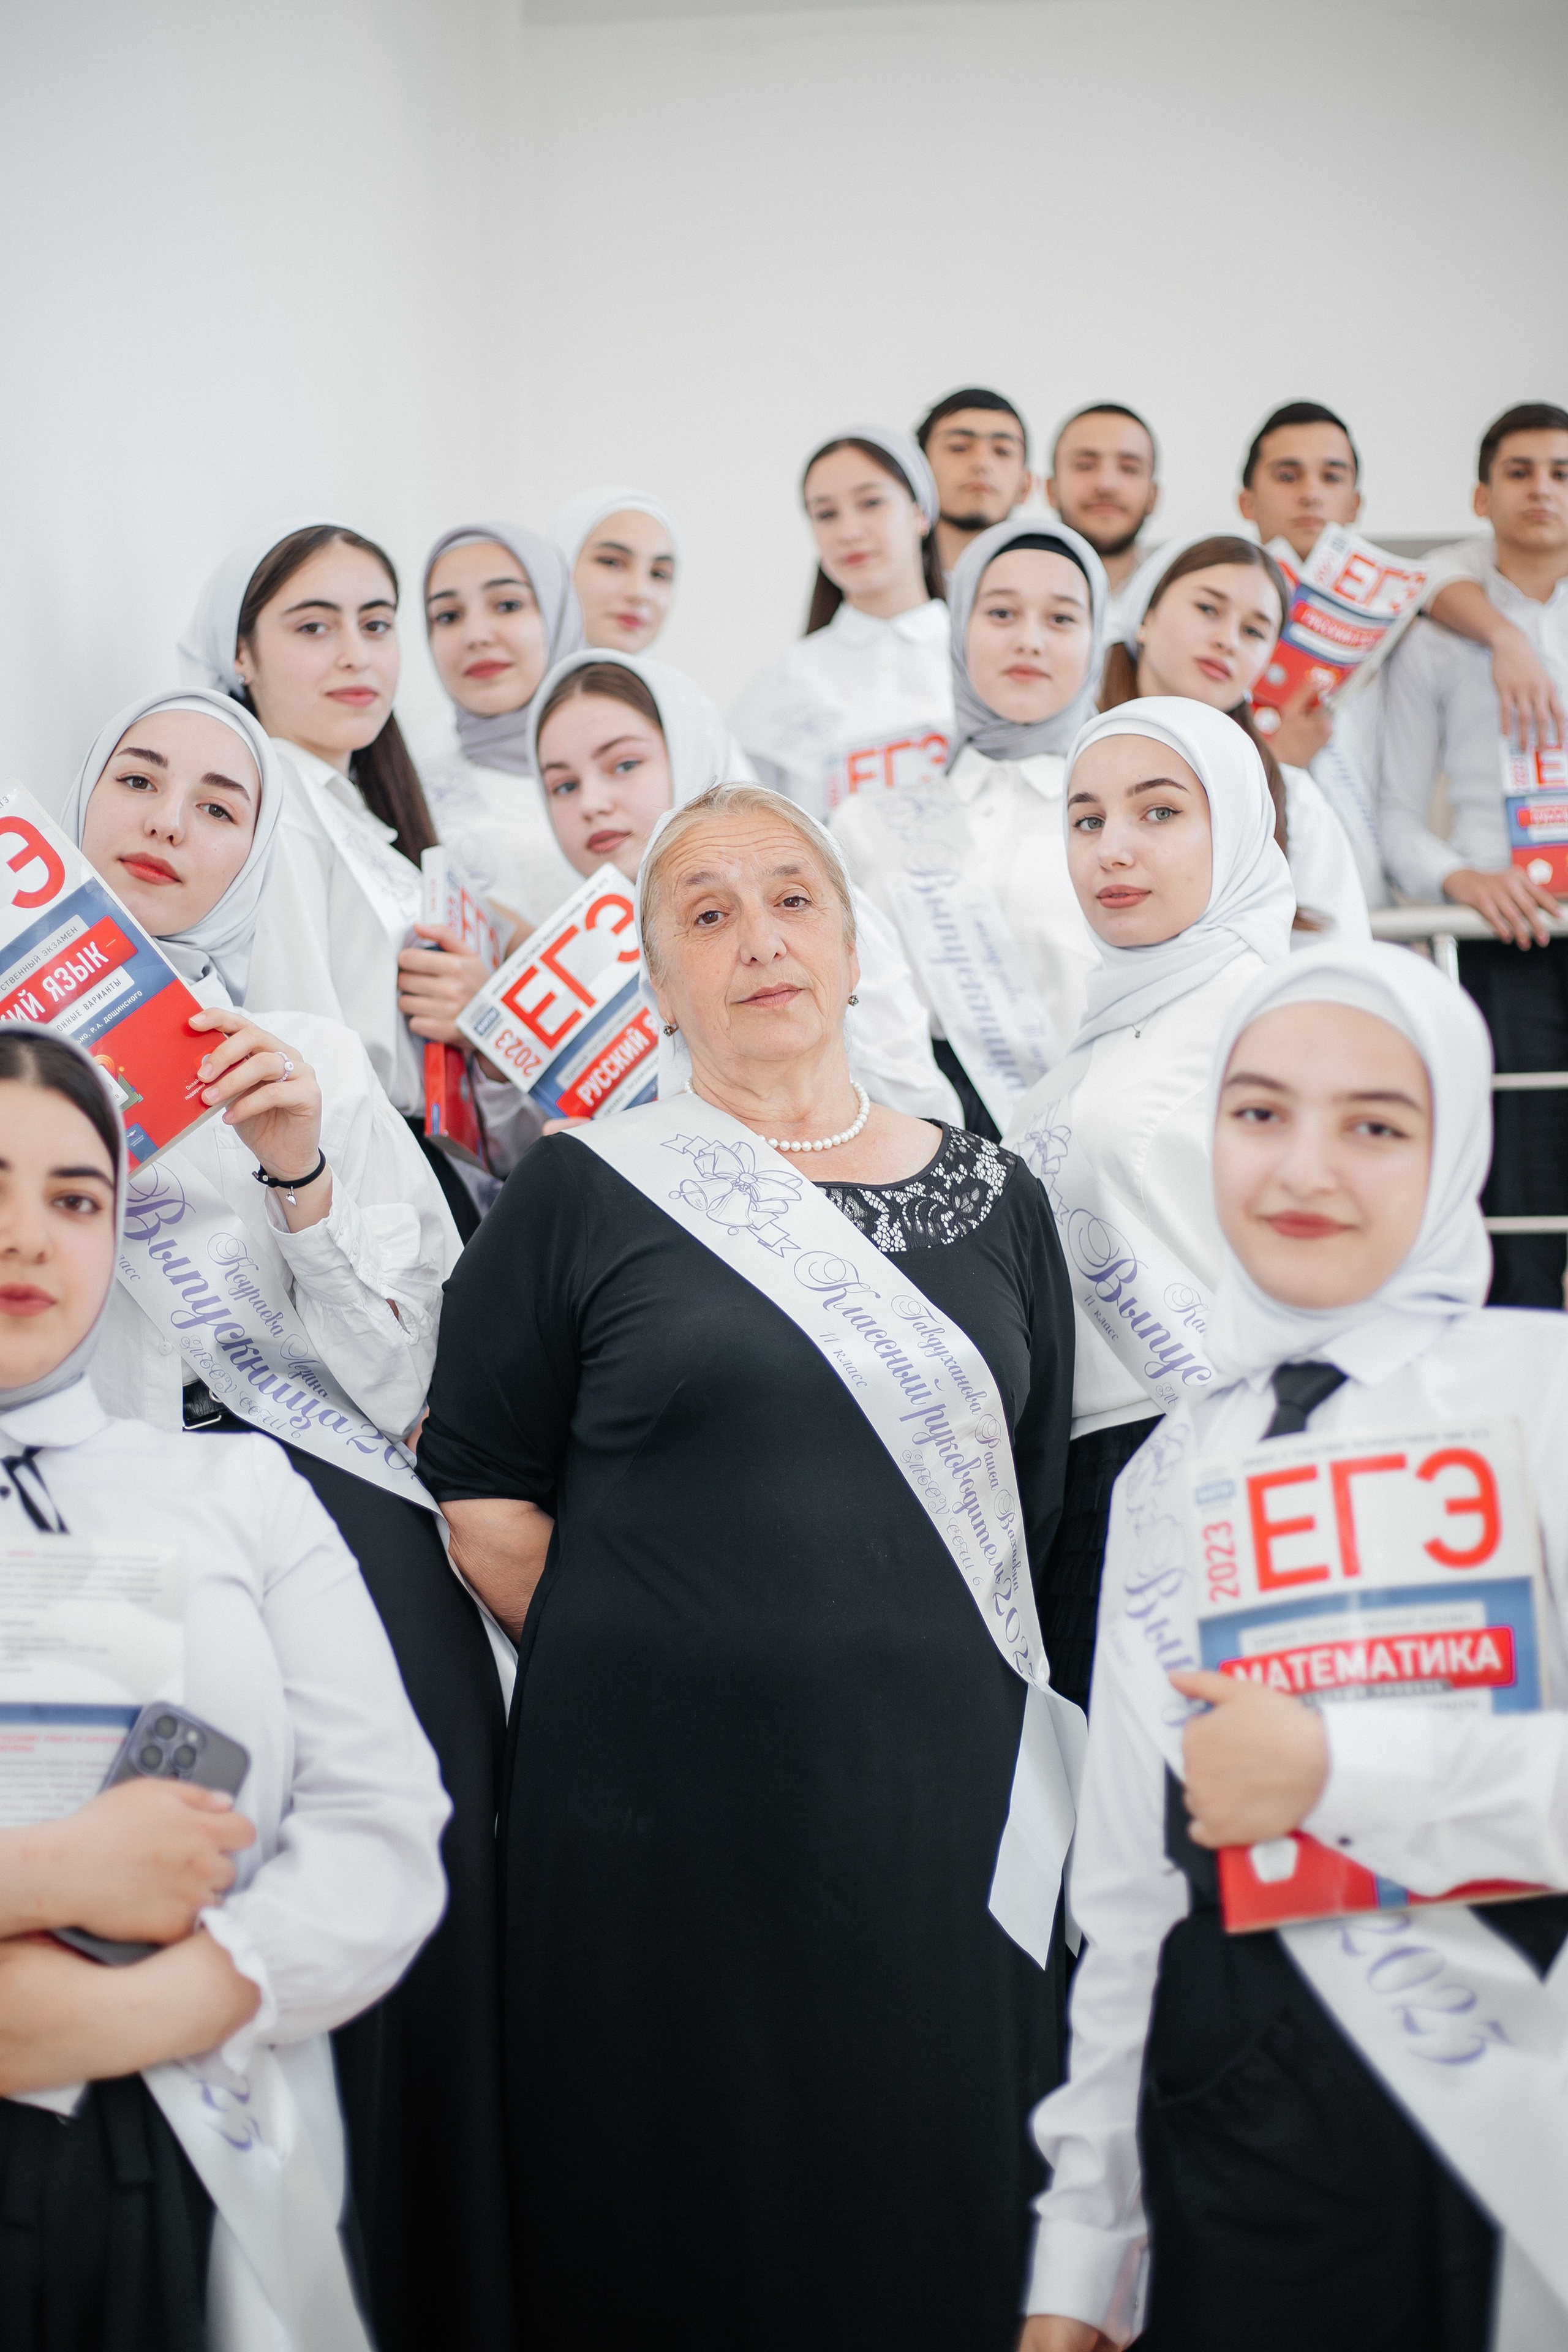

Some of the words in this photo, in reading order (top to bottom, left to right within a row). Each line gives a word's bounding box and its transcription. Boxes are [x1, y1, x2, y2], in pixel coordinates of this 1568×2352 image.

[0, 955, 42, 992] СТВЕННЫЙ
[42, 926, 78, 957] ЭКЗАМЕН
[42, 941, 110, 1003] ЯЗЫК
[500, 892, 641, 1052] ЕГЭ
[56, 1009, 82, 1031] ОННЫЕ
[83, 978, 122, 1011] ВАРИАНТЫ
[76, 1032, 91, 1044] ЬКО,
[103, 990, 143, 1024] ДОЩИНСКОГО
[495, 1029, 542, 1077] 2023
[577, 1027, 650, 1107] РУССКИЙ
[119, 1254, 141, 1281] асс
[1068, 1208, 1212, 1387] Выпус
[124, 1161, 352, 1432] Выпускница
[346, 1423, 428, 1490] 20
[1084, 1294, 1096, 1306] 11
[1094, 1310, 1119, 1341] класс
[179, 1334, 237, 1395] МБОУ
[239, 1390, 288, 1431] СОШ
[290, 1428, 301, 1439] 6
[819, 1330, 840, 1343] 11
[833, 1349, 868, 1388] класс
[891, 1294, 987, 1415] Гавдуханова
[974, 1414, 1002, 1491] Раиса
[794, 1251, 945, 1405] Классный
[899, 1403, 1004, 1585] руководитель
[899, 1449, 950, 1515] МБОУ
[946, 1517, 974, 1571] СОШ
[973, 1576, 984, 1586] 6
[1246, 1446, 1503, 1593] ЕГЭ
[1203, 1521, 1241, 1604] 2023
[1231, 1634, 1504, 1692] МАТЕМАТИКА
